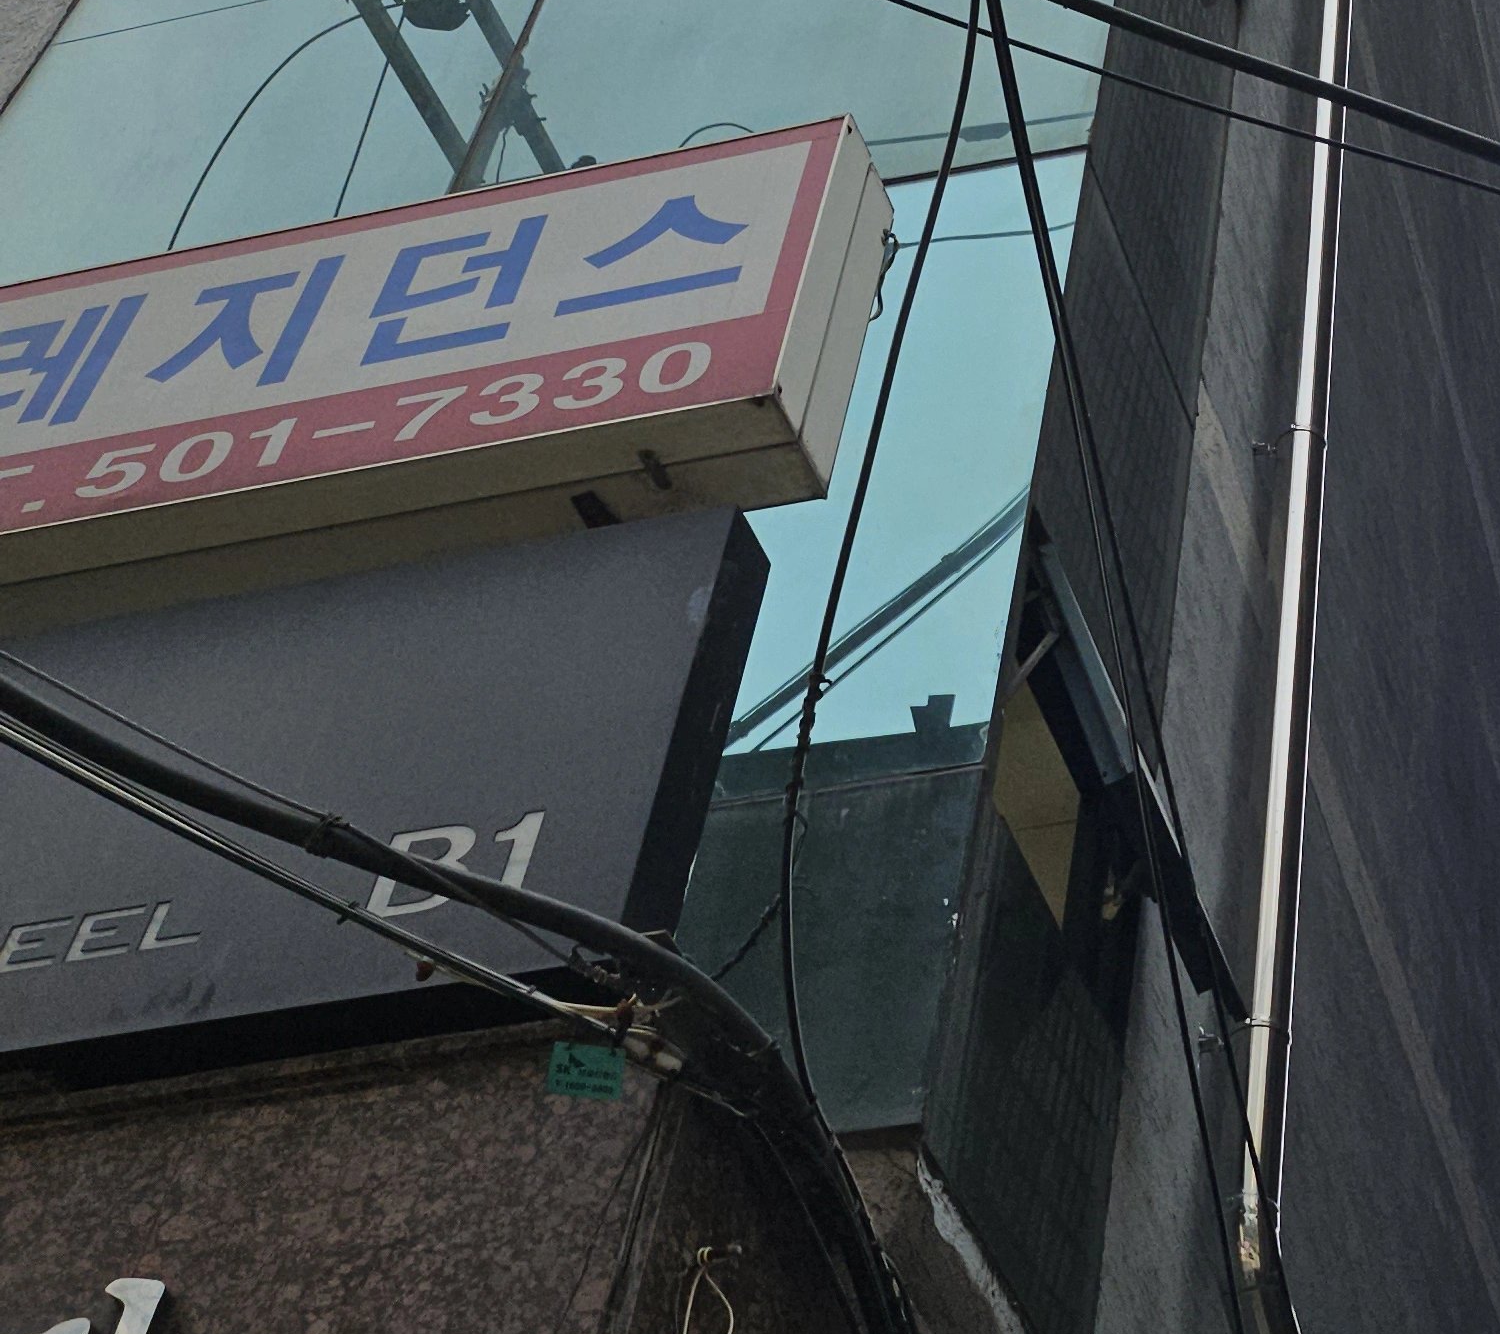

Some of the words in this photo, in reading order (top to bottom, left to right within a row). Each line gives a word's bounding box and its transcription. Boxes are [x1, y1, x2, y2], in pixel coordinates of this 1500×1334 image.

[0, 194, 748, 426] 레지던스
[74, 341, 712, 499] 501-7330
[366, 808, 547, 918] B1
